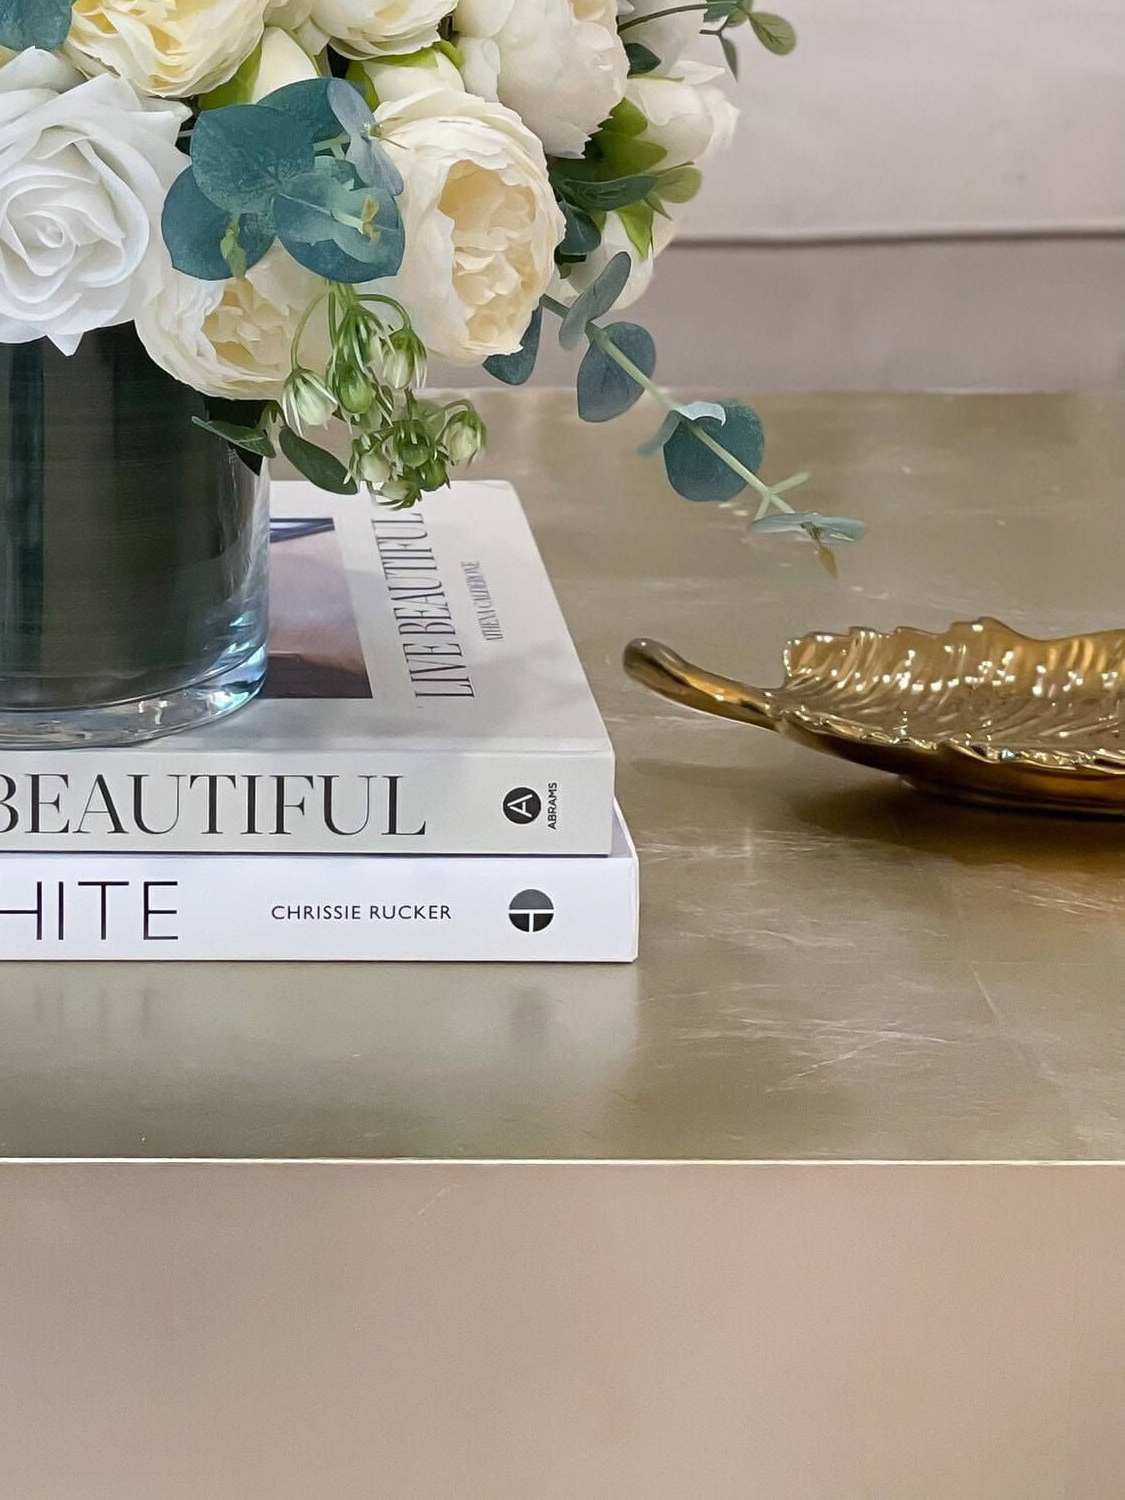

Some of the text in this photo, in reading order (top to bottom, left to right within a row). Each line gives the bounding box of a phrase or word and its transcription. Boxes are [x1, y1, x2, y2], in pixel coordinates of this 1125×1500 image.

[371, 513, 475, 698] LIVE BEAUTIFUL
[547, 782, 557, 830] ABRAMS
[271, 905, 452, 920] CHRISSIE RUCKER
